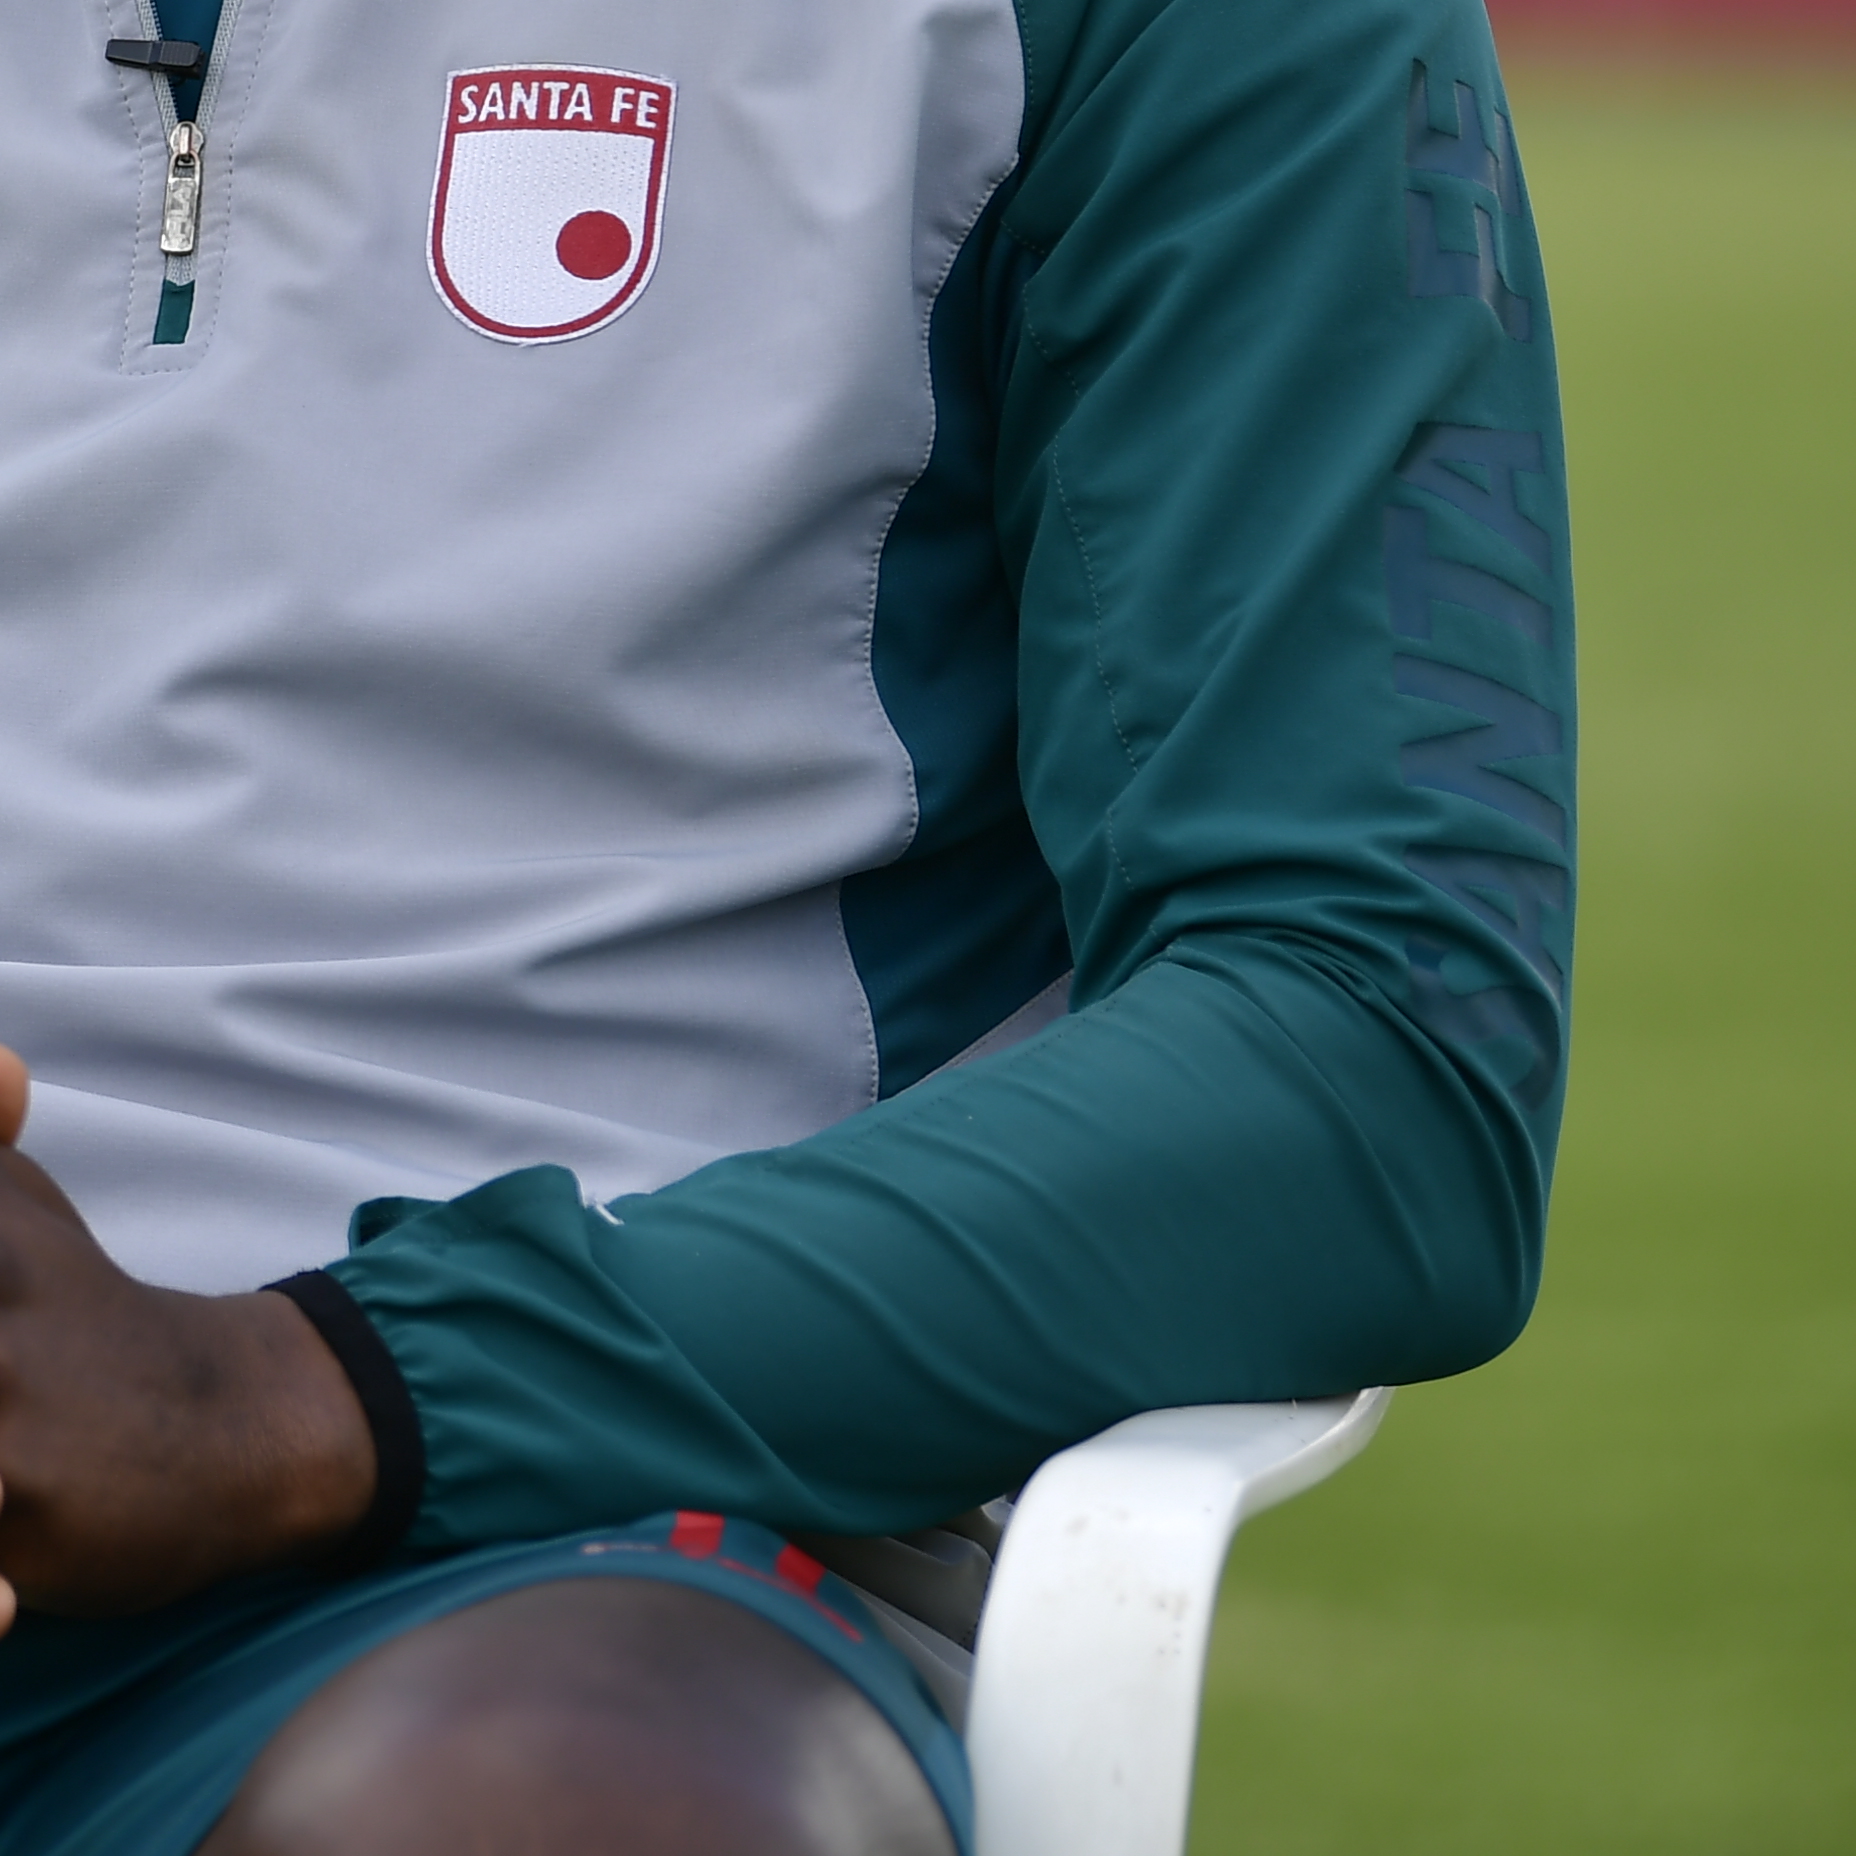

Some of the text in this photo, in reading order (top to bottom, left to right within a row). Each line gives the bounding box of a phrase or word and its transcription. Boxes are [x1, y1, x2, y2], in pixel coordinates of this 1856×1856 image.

[457, 80, 661, 129] SANTA FE
[1404, 56, 1532, 344] FE
